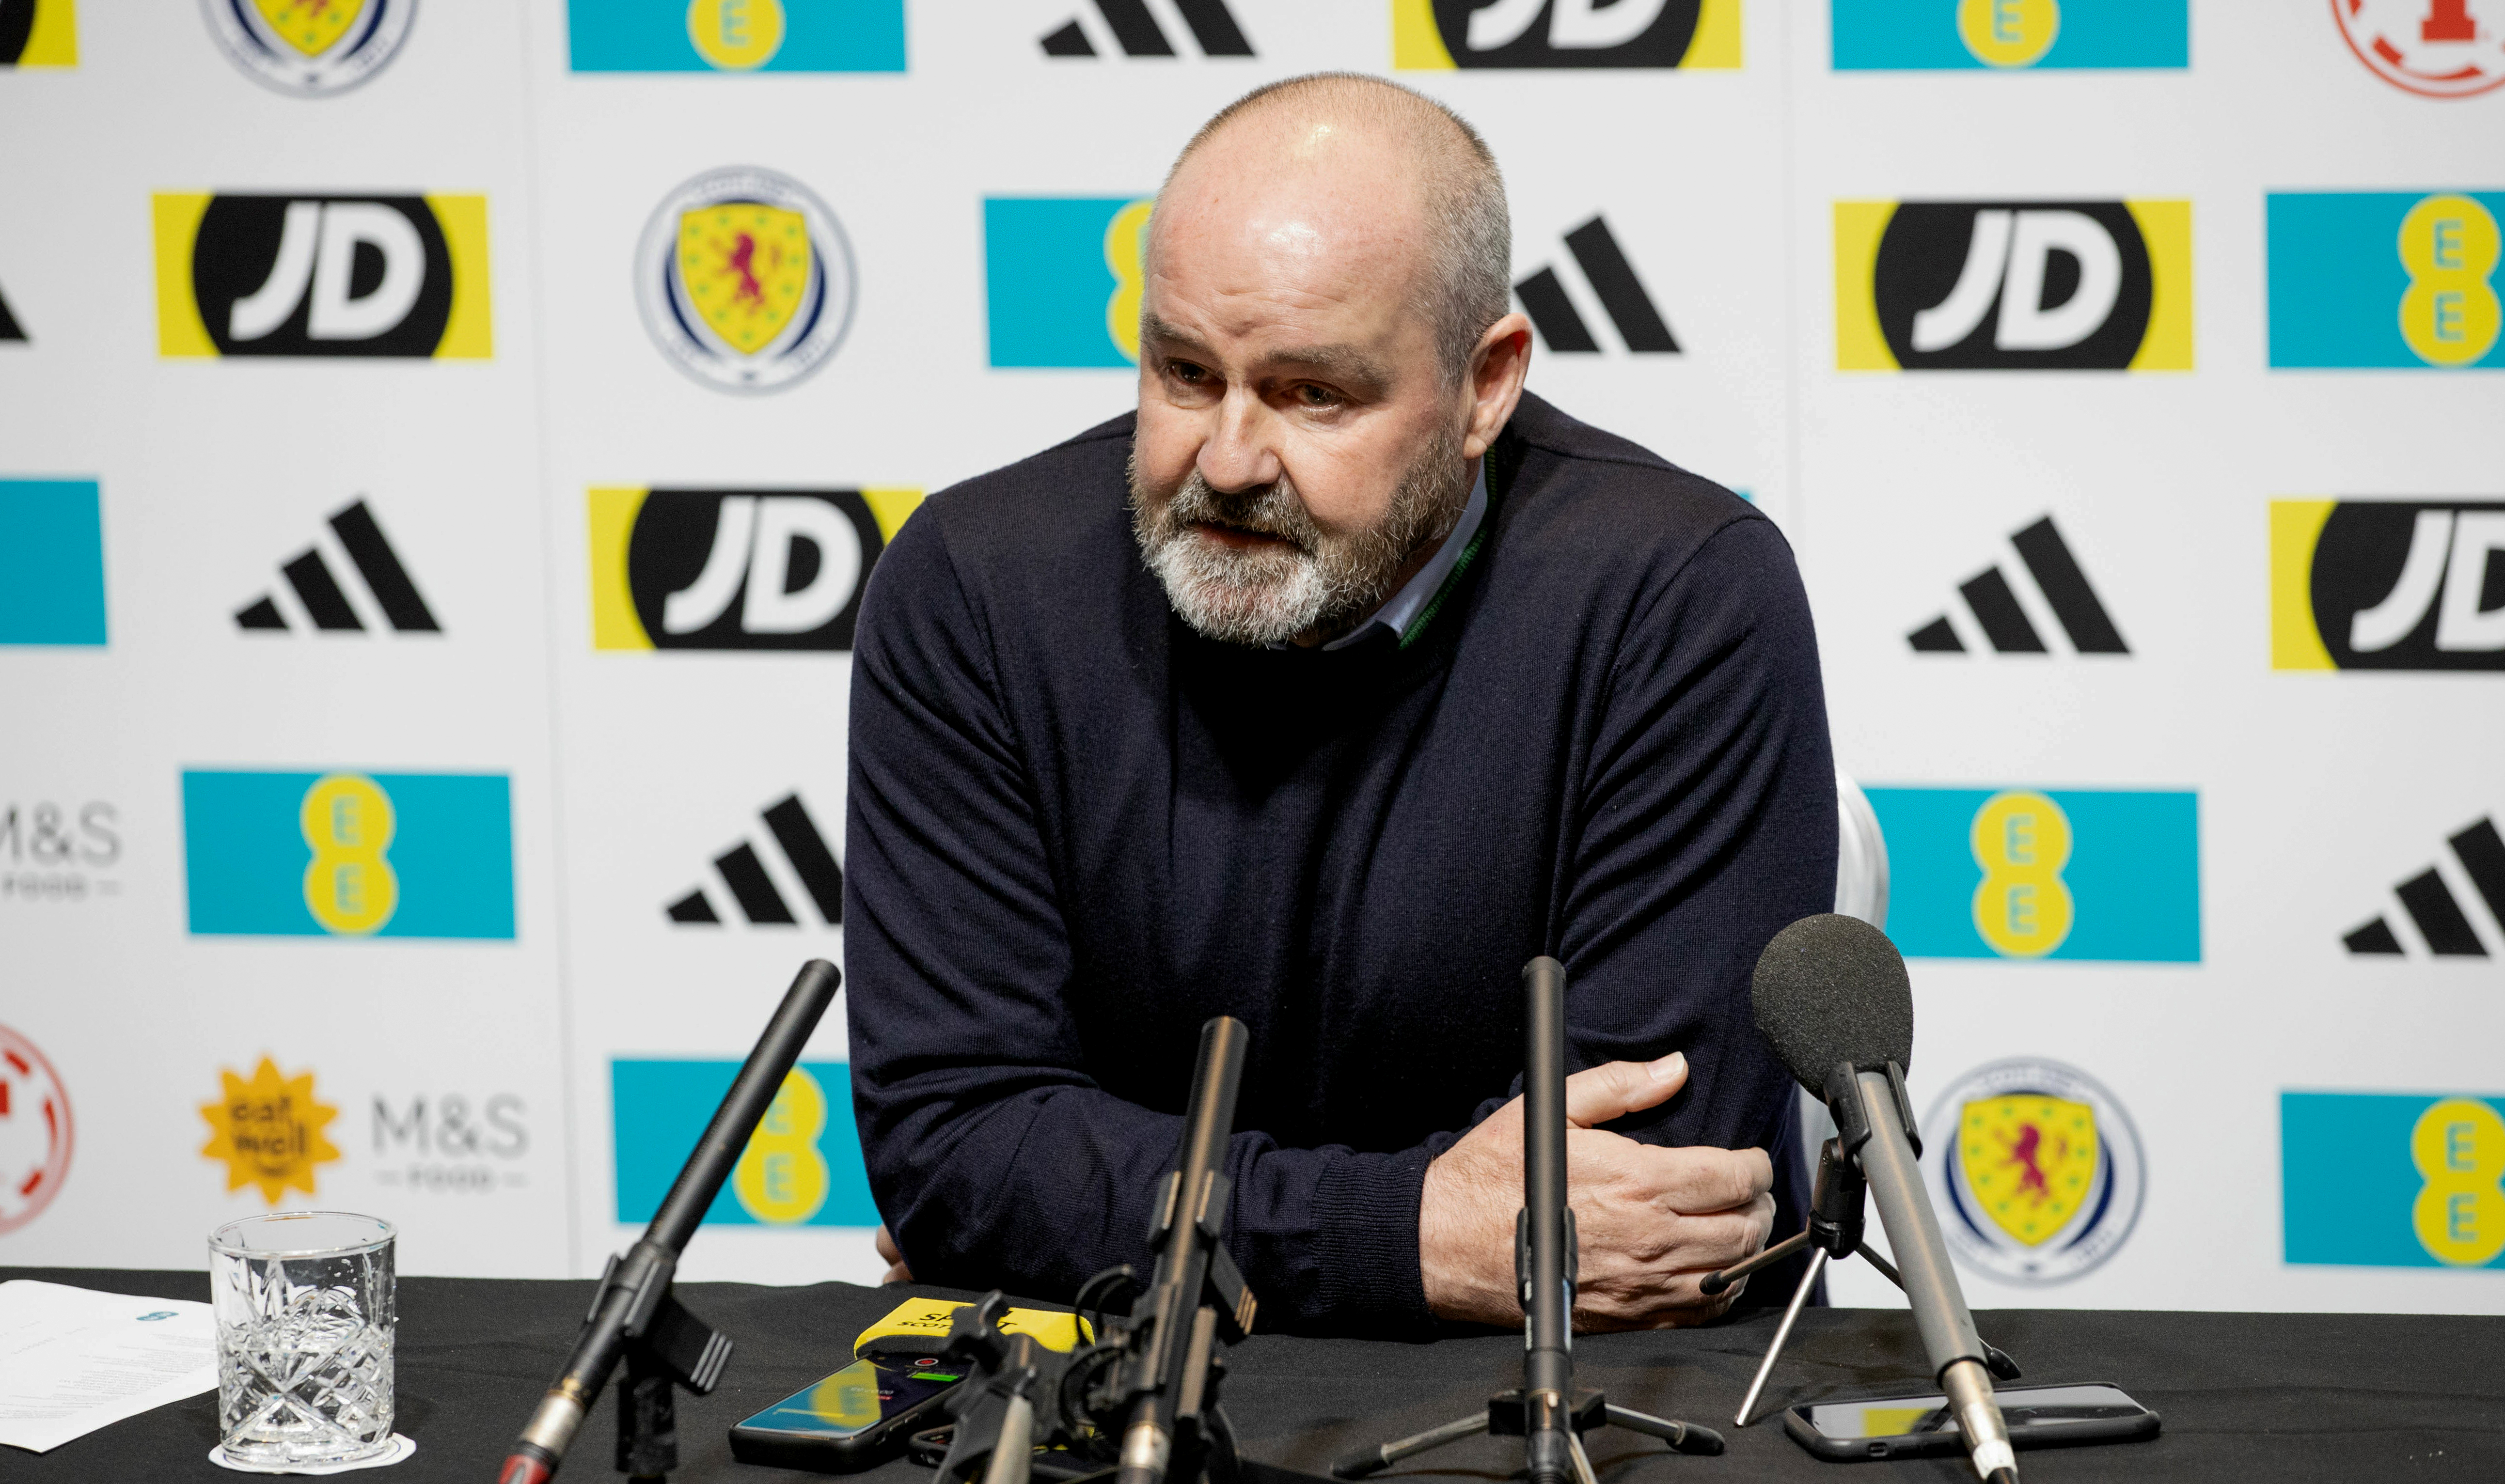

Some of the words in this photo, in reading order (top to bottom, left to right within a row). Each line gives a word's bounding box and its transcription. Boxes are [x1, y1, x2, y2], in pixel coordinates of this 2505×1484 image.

[230, 201, 426, 341] JD
[1910, 209, 2123, 353] JD
[662, 495, 862, 635] JD
[370, 1092, 530, 1160] M&S
